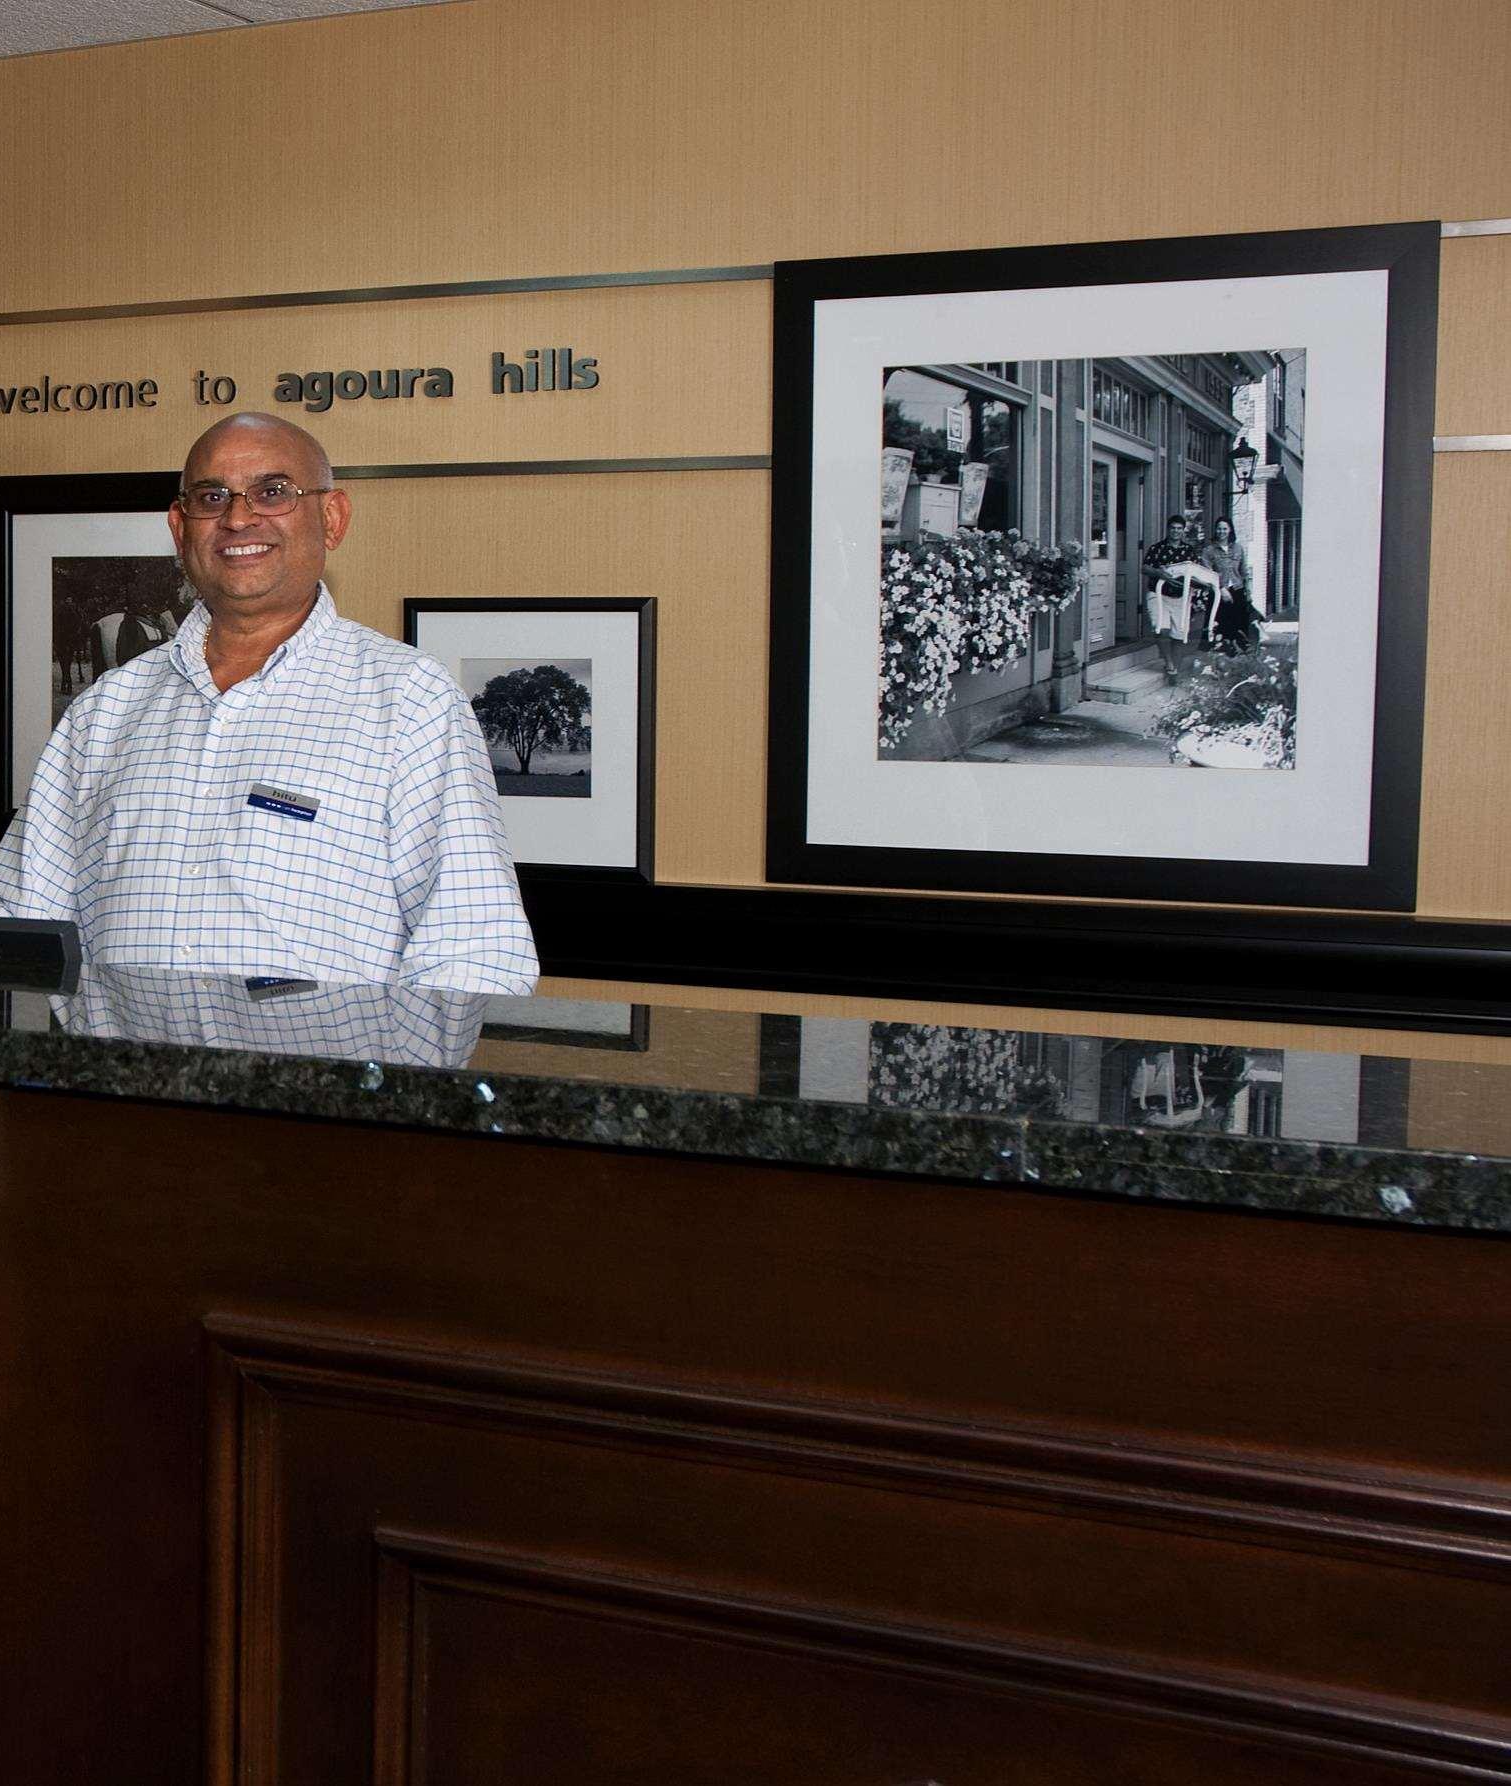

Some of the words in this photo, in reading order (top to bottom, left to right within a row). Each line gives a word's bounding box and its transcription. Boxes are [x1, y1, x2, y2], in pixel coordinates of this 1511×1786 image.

[193, 370, 237, 405] to
[273, 367, 455, 413] agoura
[491, 347, 600, 395] hills
